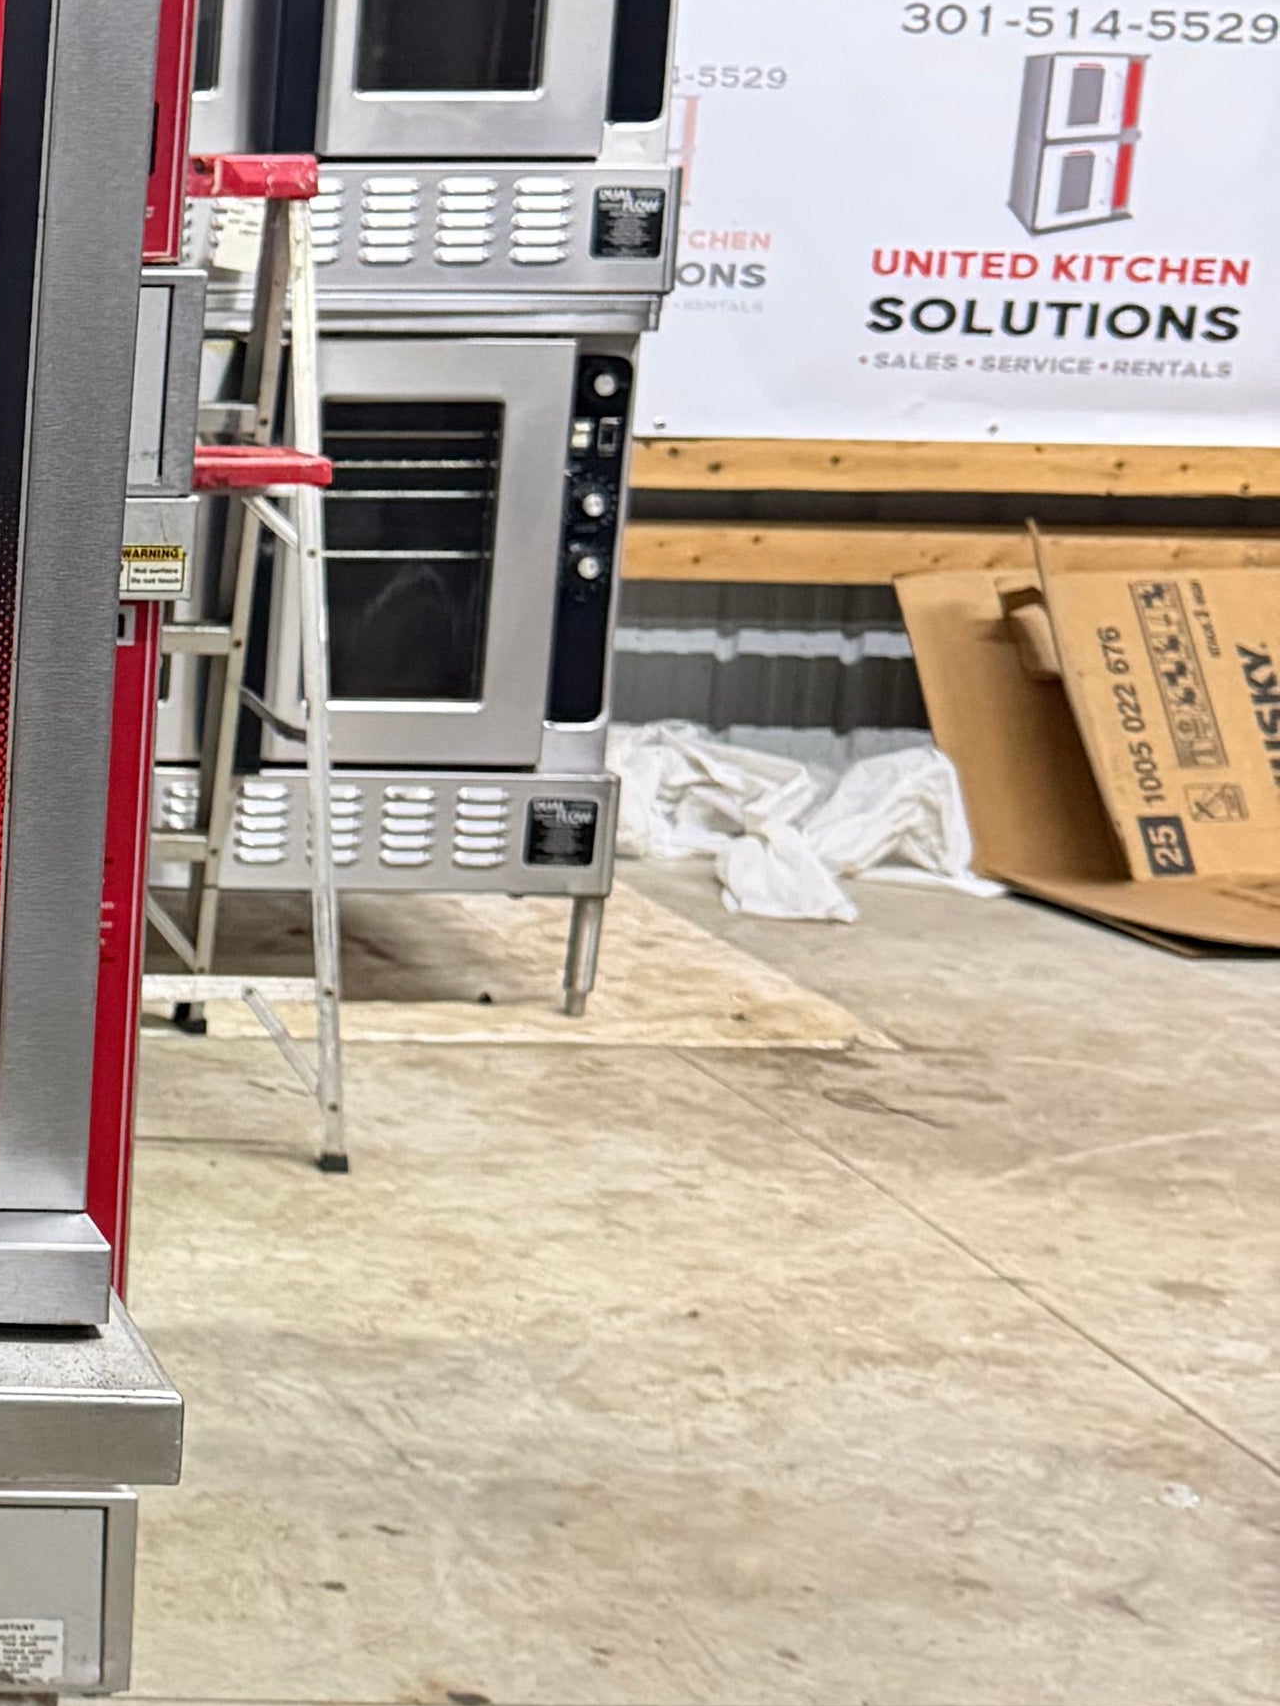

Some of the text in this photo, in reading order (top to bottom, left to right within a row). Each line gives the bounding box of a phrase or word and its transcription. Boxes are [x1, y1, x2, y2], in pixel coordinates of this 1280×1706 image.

[901, 2, 1279, 45] 301-514-5529
[871, 248, 1250, 286] UNITED KITCHEN
[867, 297, 1240, 341] SOLUTIONS
[874, 352, 1233, 379] SALES SERVICE RENTALS
[121, 548, 179, 559] WARNING
[1097, 626, 1130, 675] 676
[1147, 824, 1185, 869] 25
